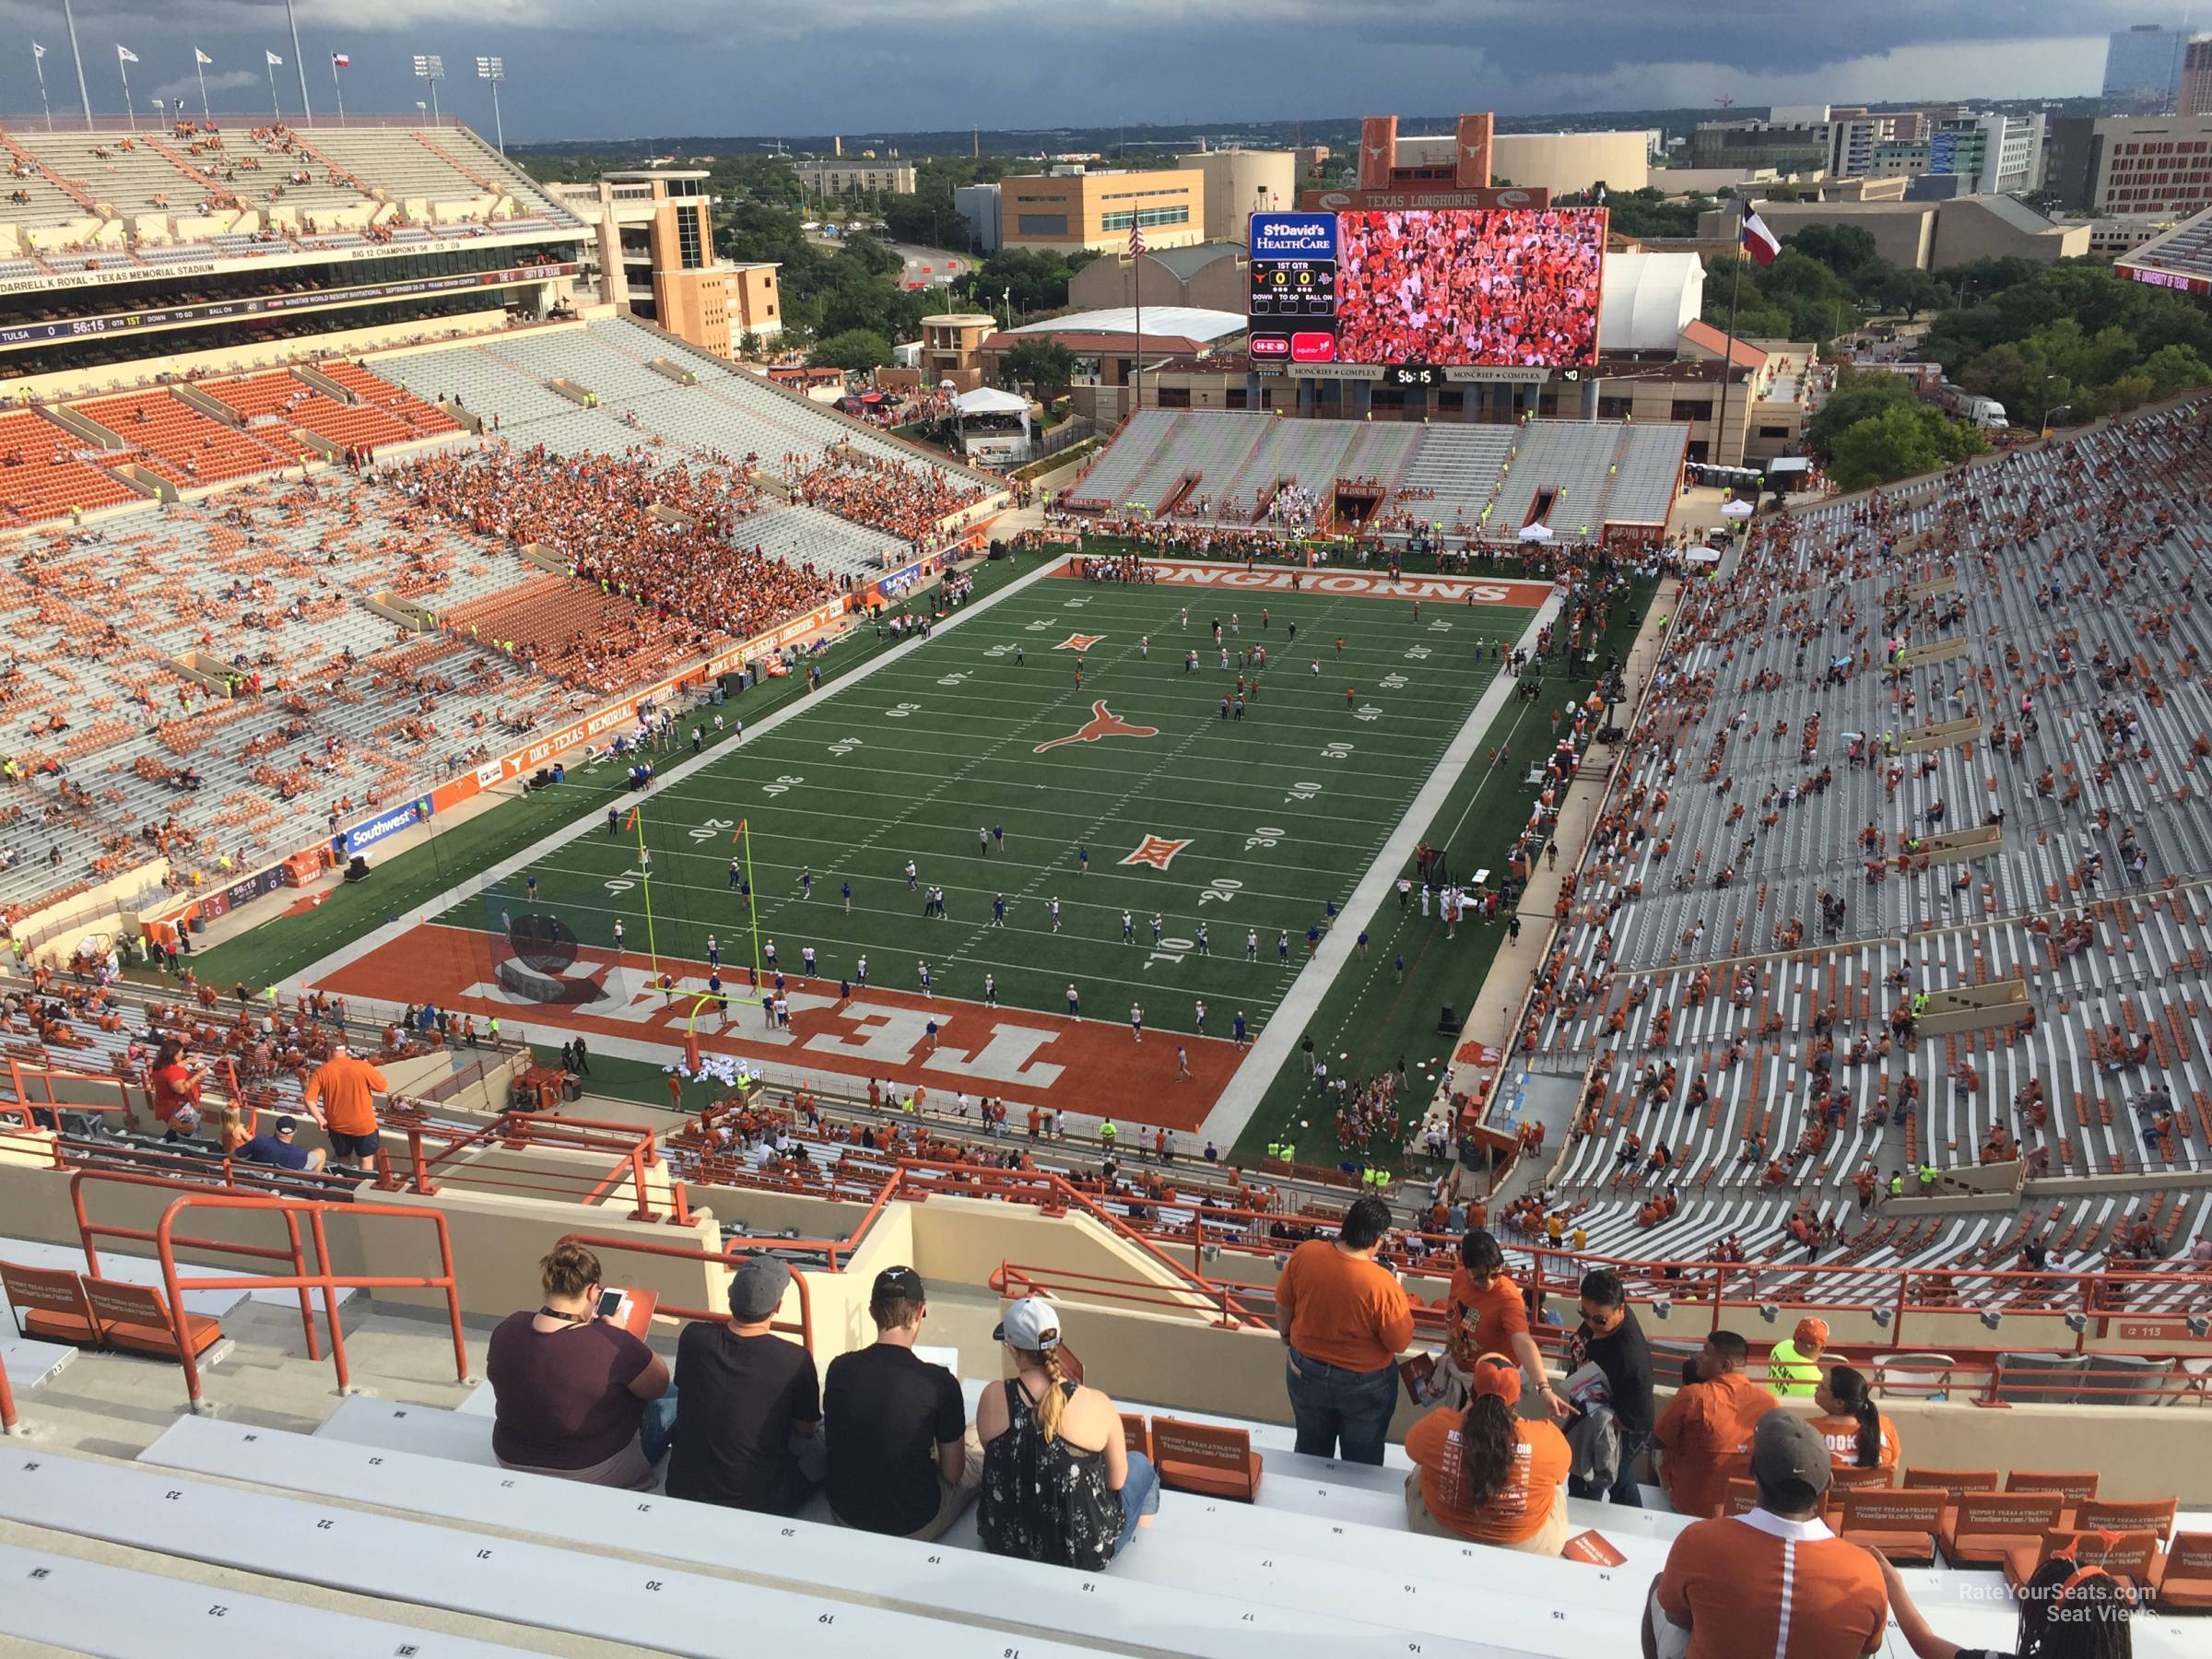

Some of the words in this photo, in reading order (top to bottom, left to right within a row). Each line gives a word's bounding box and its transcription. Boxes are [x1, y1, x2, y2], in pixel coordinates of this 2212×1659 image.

[1366, 194, 1405, 207] TEXAS
[1411, 194, 1478, 207] LONGHORNS
[352, 250, 364, 259] BIG
[367, 249, 373, 257] 12
[376, 245, 416, 255] CHAMPIONS
[1, 278, 46, 293] DARRELL
[48, 279, 54, 288] K
[58, 274, 88, 287] ROYAL
[96, 272, 127, 283] TEXAS
[130, 267, 175, 280] MEMORIAL
[178, 264, 215, 275] STADIUM
[1276, 272, 1285, 284] 0
[1300, 272, 1310, 284] 0
[112, 319, 124, 327] QTR
[126, 316, 140, 326] 1ST
[147, 314, 166, 323] DOWN
[48, 326, 55, 335] 0
[73, 320, 105, 334] 56:15
[2, 330, 29, 341] TULSA
[1397, 370, 1431, 383] 56:15
[1453, 371, 1494, 379] MONCRIEF
[1565, 370, 1579, 382] 40
[1141, 564, 1512, 601] ONGHORNS
[529, 724, 585, 763] DKR-TEXAS
[588, 704, 634, 735] MEMORIAL
[636, 686, 674, 708] STDIUM
[353, 809, 409, 846] Southwest
[688, 818, 735, 839] 20
[1245, 826, 1286, 848] 30
[300, 868, 321, 885] TEXAS
[233, 878, 257, 896] 56:15
[269, 879, 277, 888] 0
[1200, 878, 1243, 902] 20
[215, 905, 222, 915] 0
[1150, 937, 1195, 964] 10
[165, 1490, 182, 1500] 23
[637, 1503, 651, 1512] 21
[316, 1519, 335, 1530] 22
[781, 1528, 795, 1537] 20
[477, 1548, 492, 1559] 21
[927, 1556, 940, 1564] 19
[645, 1581, 663, 1592] 20
[1082, 1583, 1095, 1593] 18
[1404, 1585, 1416, 1594] 16
[208, 1605, 229, 1617] 22
[1553, 1611, 1564, 1619] 15
[818, 1614, 834, 1625] 19
[1241, 1613, 1254, 1621] 17
[398, 1645, 416, 1655] 21
[1408, 1643, 1421, 1653] 16
